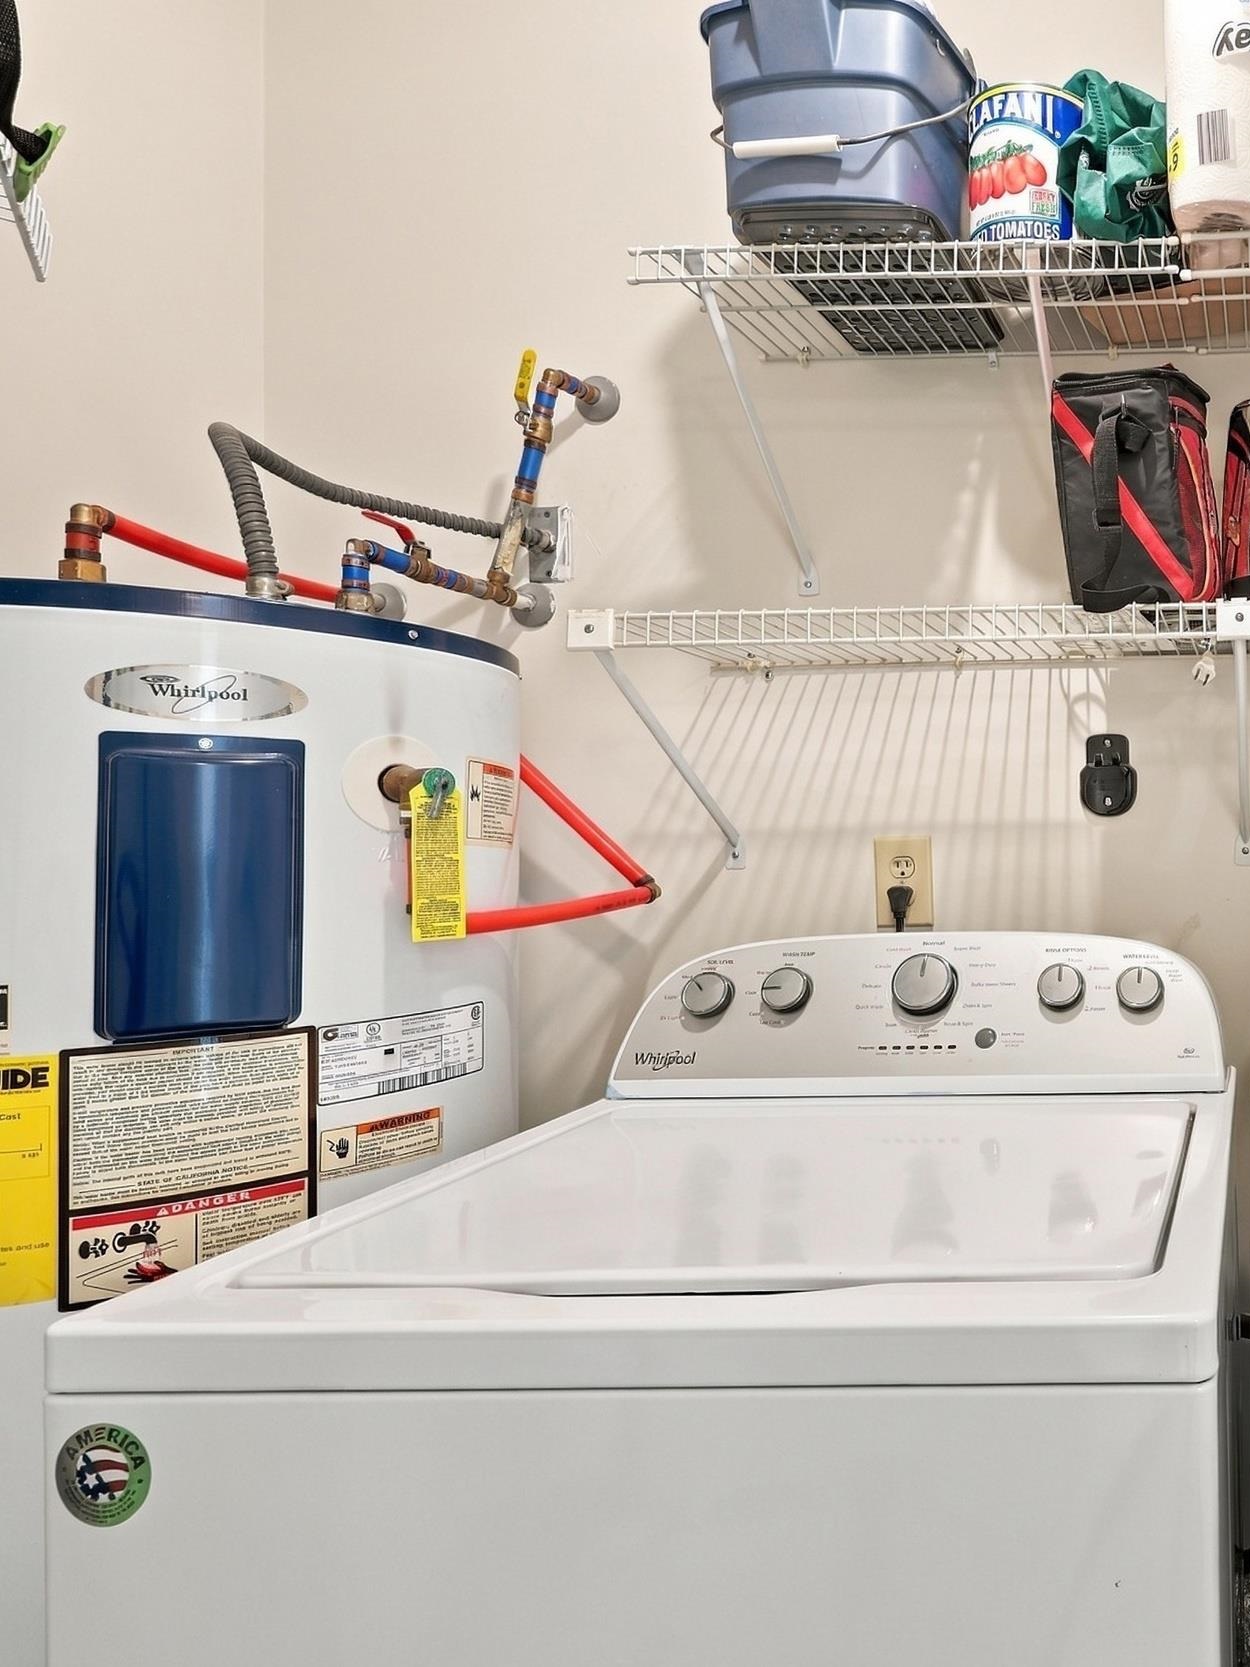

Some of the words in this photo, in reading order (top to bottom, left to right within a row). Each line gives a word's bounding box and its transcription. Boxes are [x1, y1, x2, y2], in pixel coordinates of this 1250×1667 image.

[990, 220, 1060, 240] TOMATOES
[149, 681, 248, 708] Whirlpool
[634, 1050, 696, 1071] Whirlpool
[0, 1066, 50, 1090] IDE
[0, 1112, 21, 1121] Cost
[379, 1111, 431, 1129] WARNING
[175, 1168, 220, 1182] CALIFORNIA
[220, 1164, 248, 1175] NOTICE
[172, 1191, 251, 1213] DANGER
[65, 1426, 146, 1470] AMERICA
